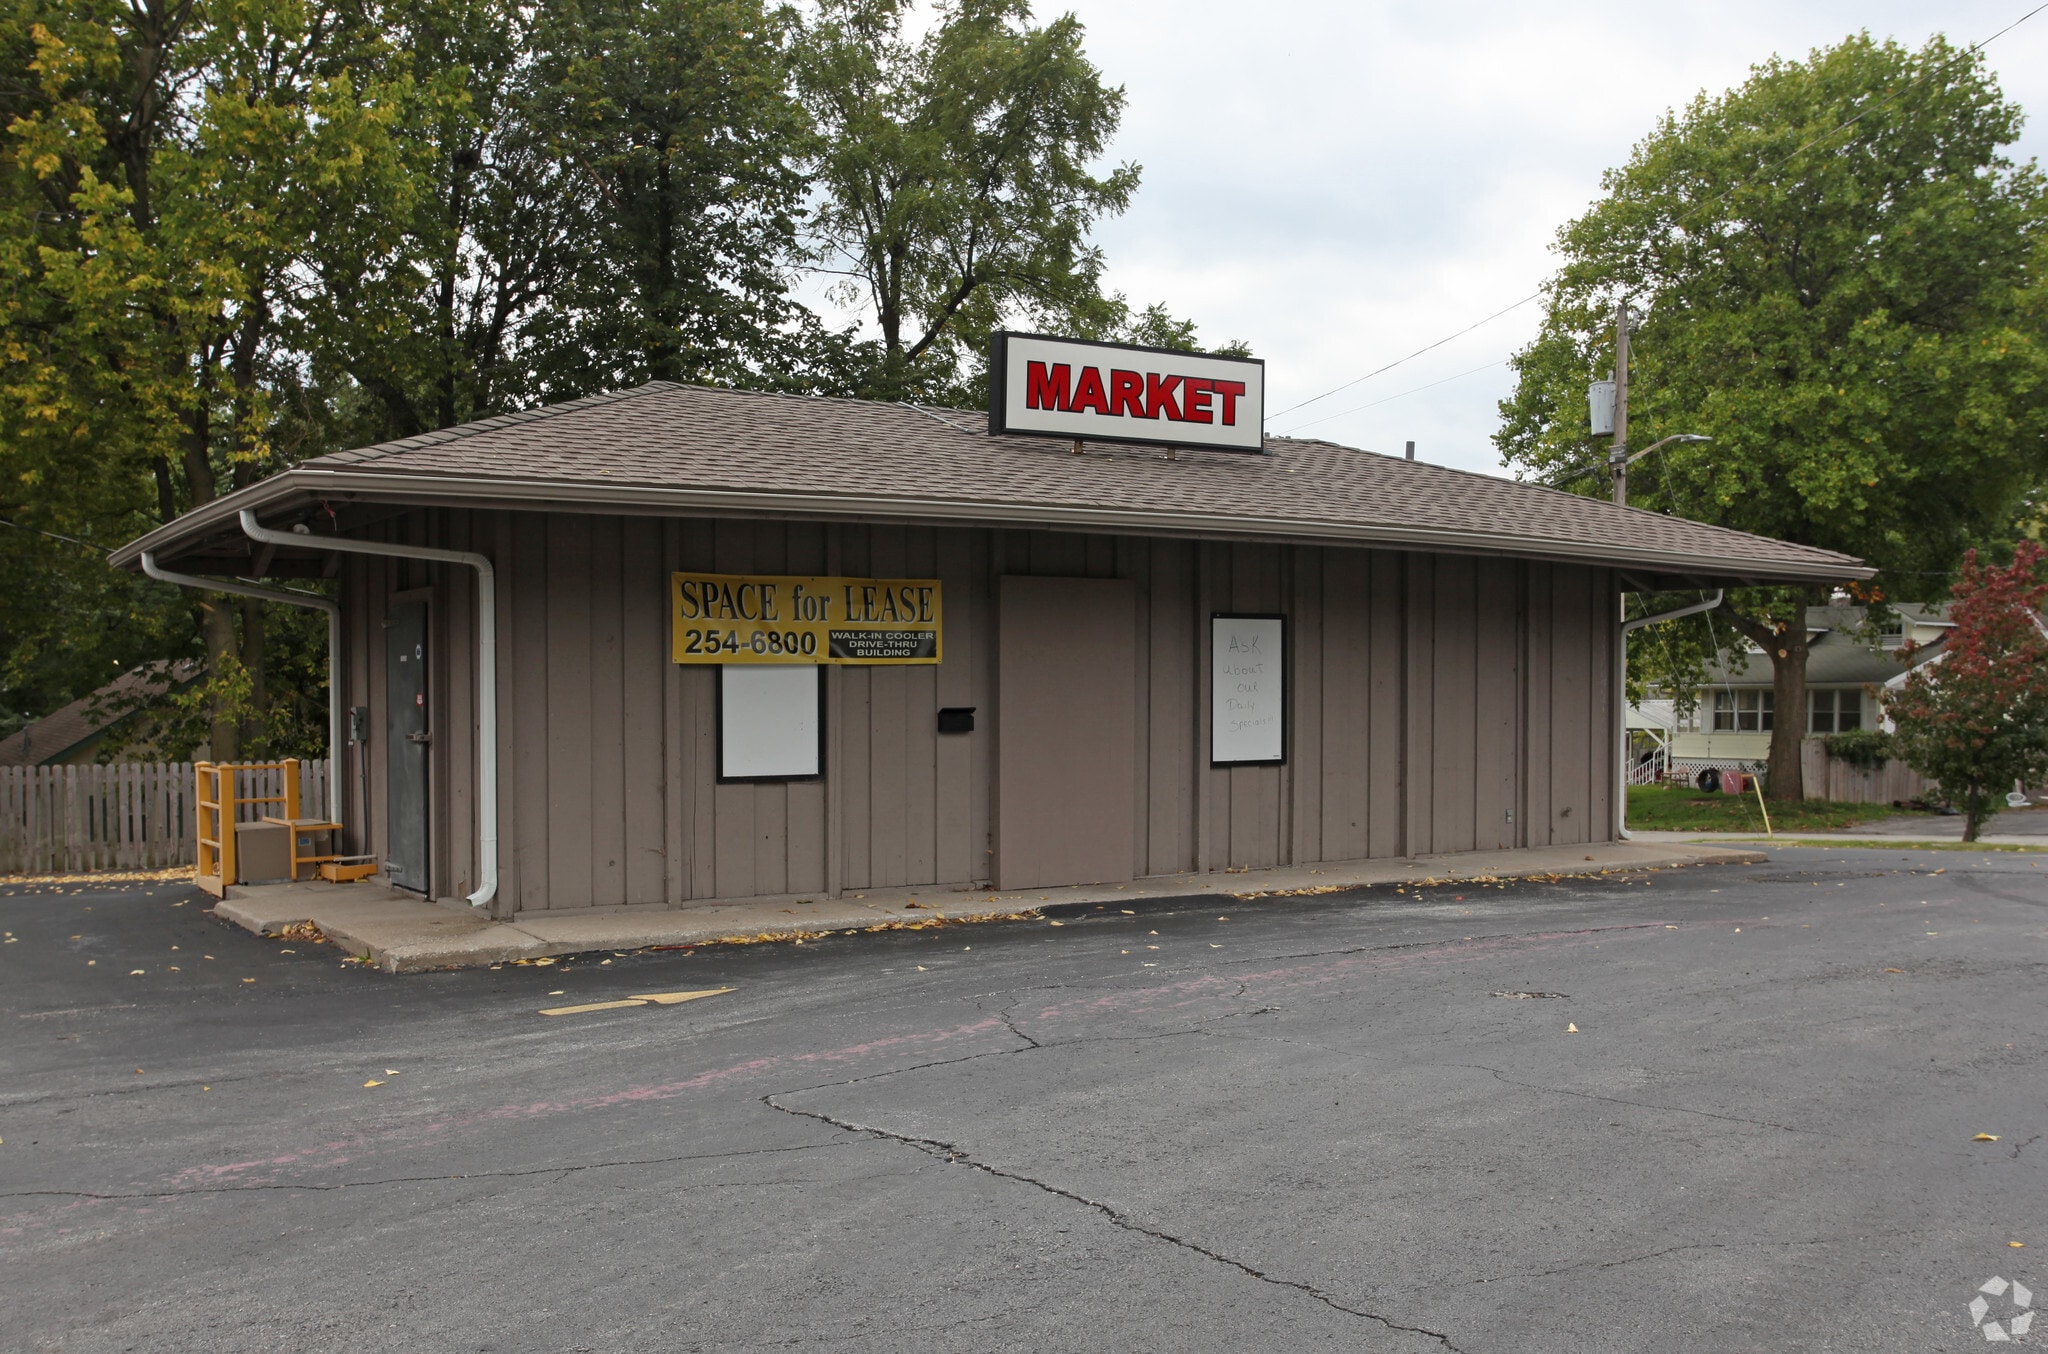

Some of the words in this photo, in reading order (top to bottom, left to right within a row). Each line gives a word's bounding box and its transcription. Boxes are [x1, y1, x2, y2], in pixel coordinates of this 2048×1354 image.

[1026, 360, 1245, 426] MARKET
[681, 580, 779, 621] SPACE
[792, 584, 831, 622] for
[843, 585, 934, 623] LEASE
[685, 629, 817, 655] 254-6800
[849, 640, 917, 648] DRIVE-THRU
[885, 632, 934, 640] COOLER
